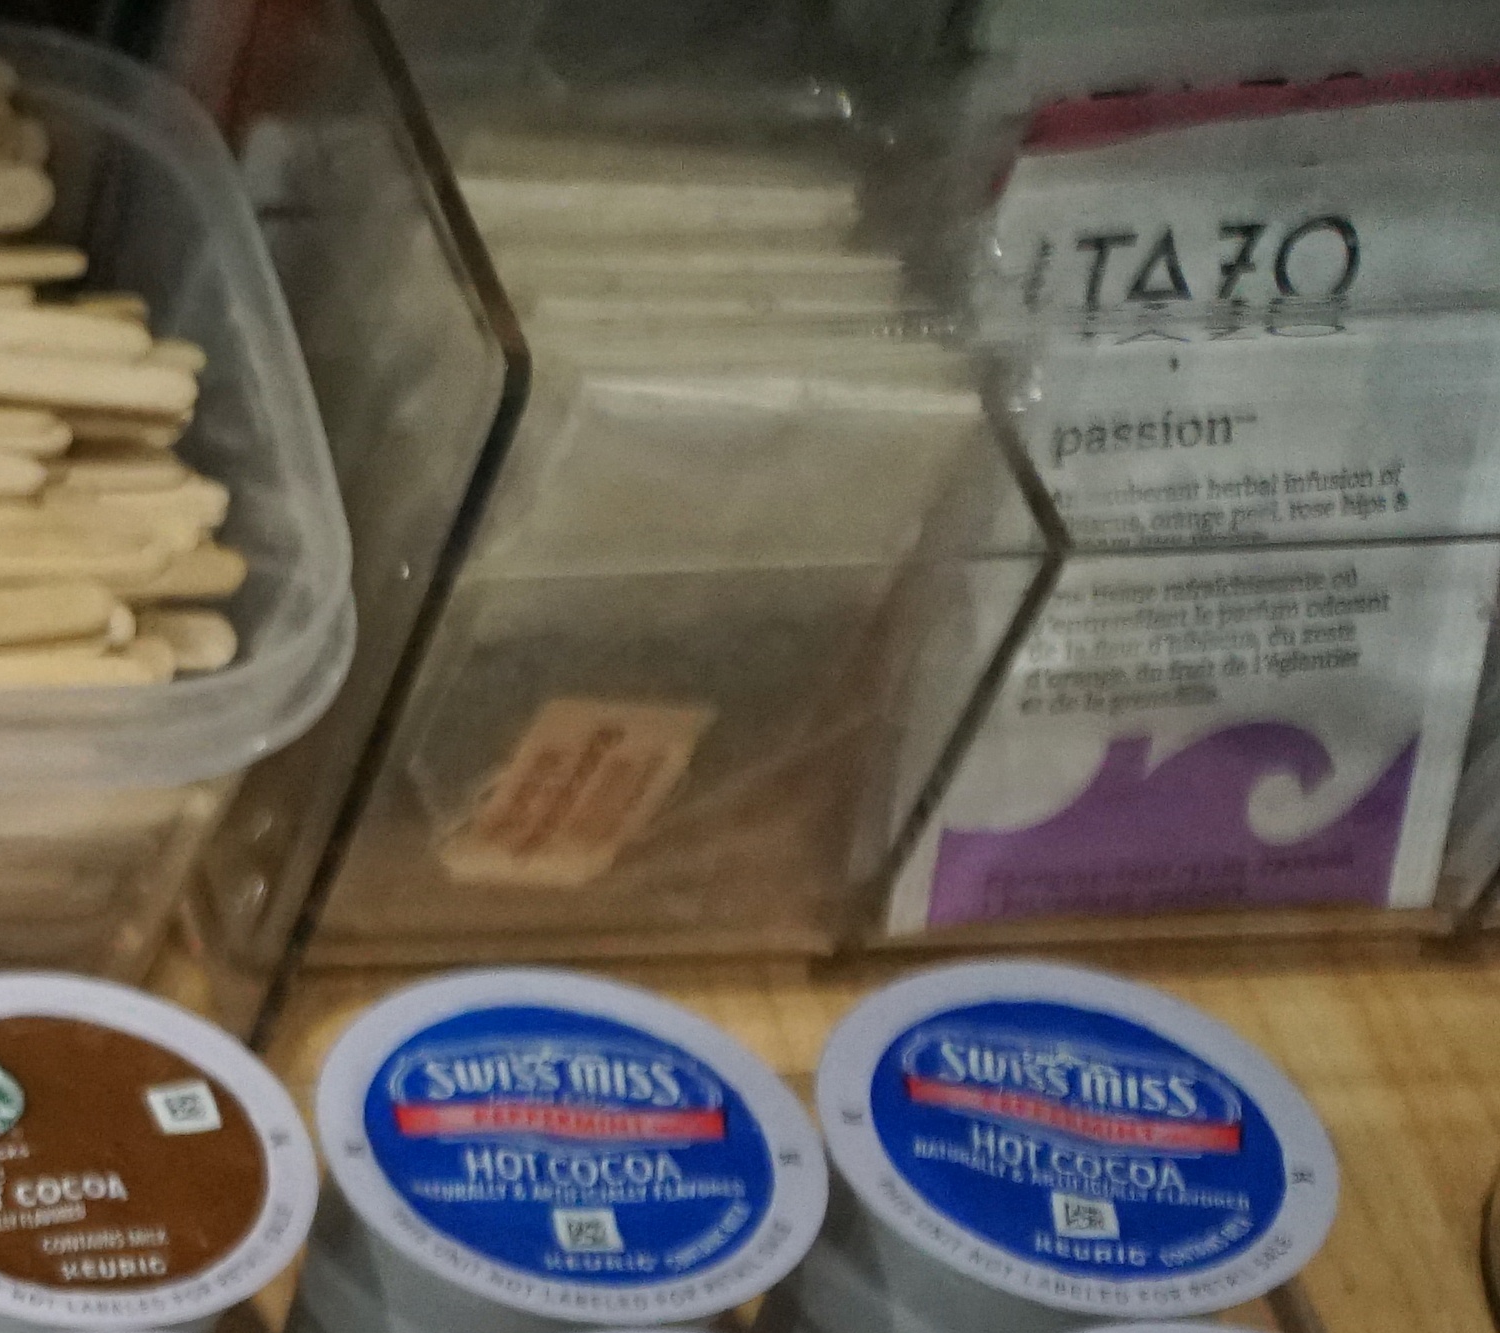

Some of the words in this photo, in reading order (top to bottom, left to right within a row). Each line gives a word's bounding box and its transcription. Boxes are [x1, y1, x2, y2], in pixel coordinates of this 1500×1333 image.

[1076, 213, 1359, 309] TAZO
[1052, 412, 1235, 463] passion
[462, 1149, 548, 1186] HOT
[550, 1149, 682, 1186] COCOA
